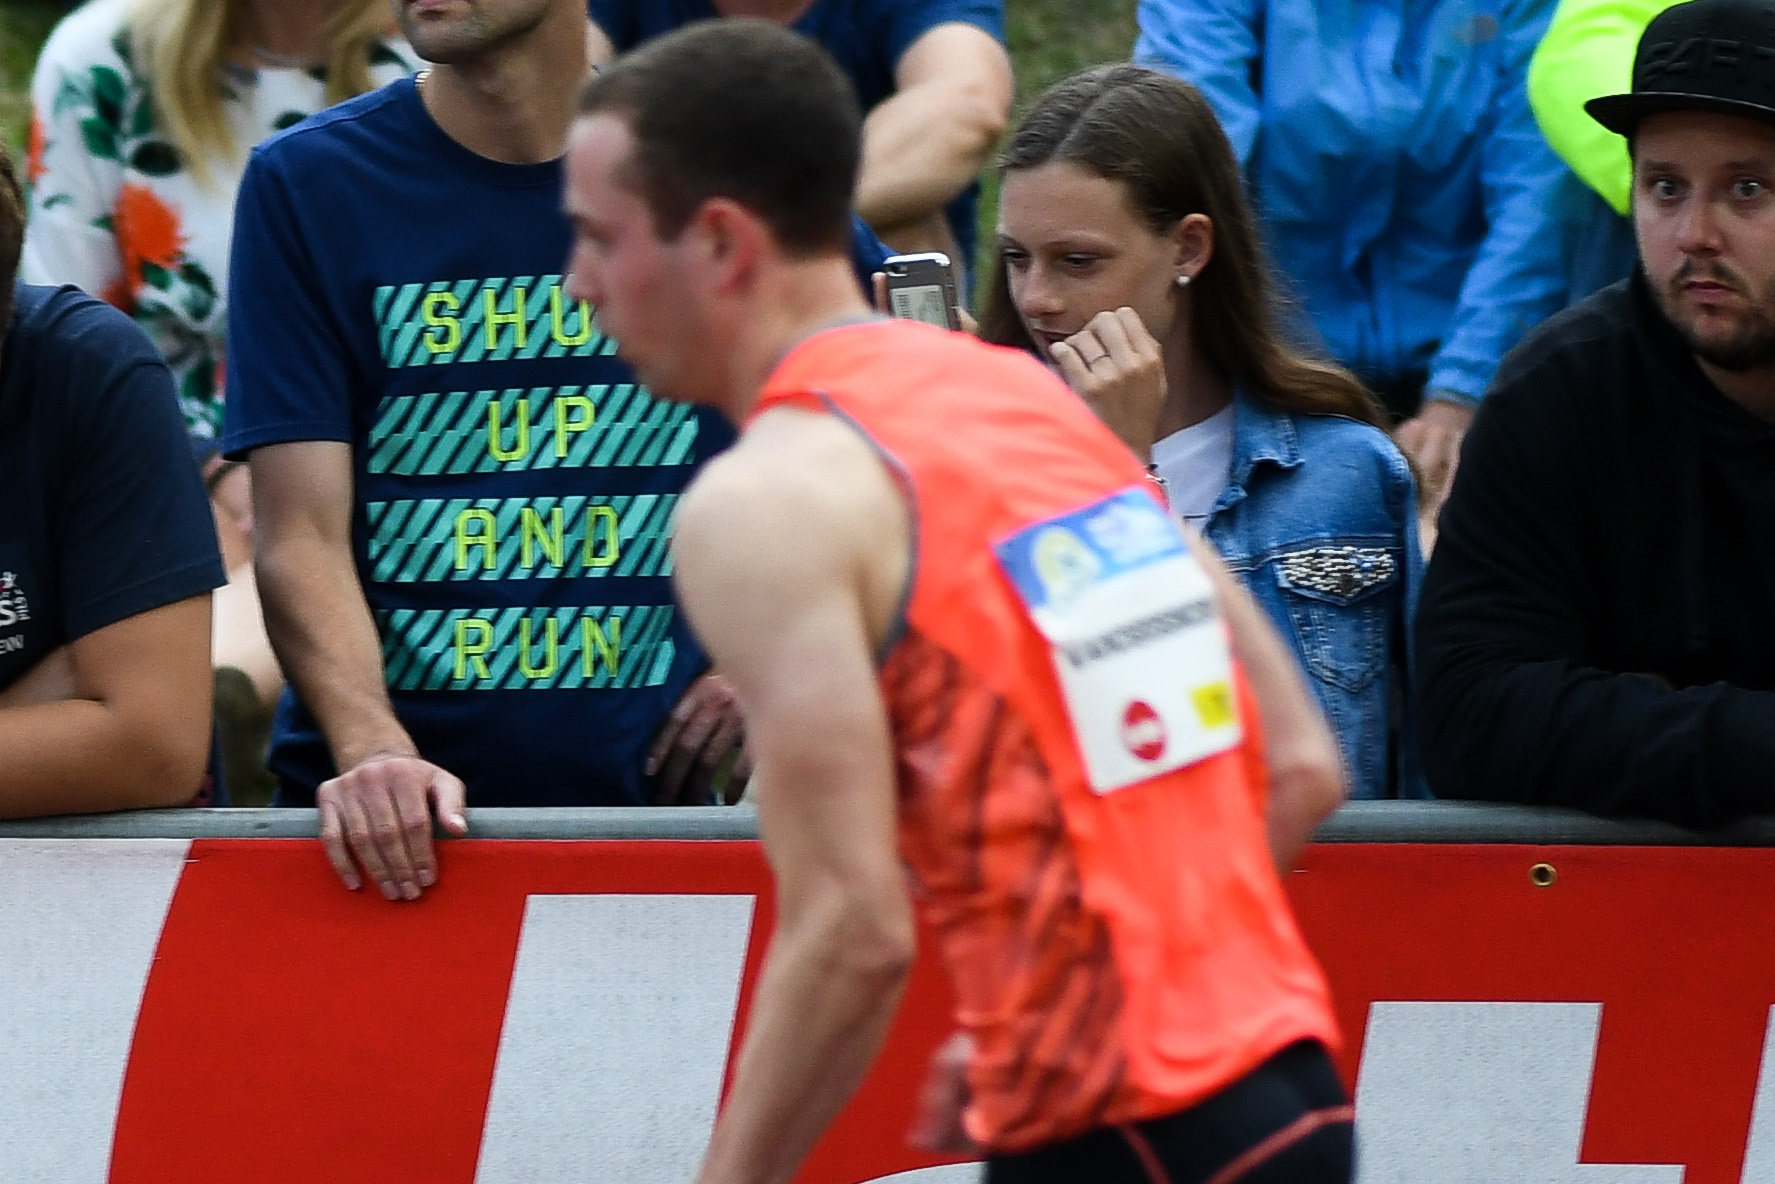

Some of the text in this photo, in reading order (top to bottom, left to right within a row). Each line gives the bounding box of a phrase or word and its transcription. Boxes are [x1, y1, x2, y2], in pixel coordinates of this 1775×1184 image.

[422, 285, 593, 354] SHU
[488, 396, 596, 462] UP
[453, 505, 621, 571] AND
[452, 616, 622, 680] RUN
